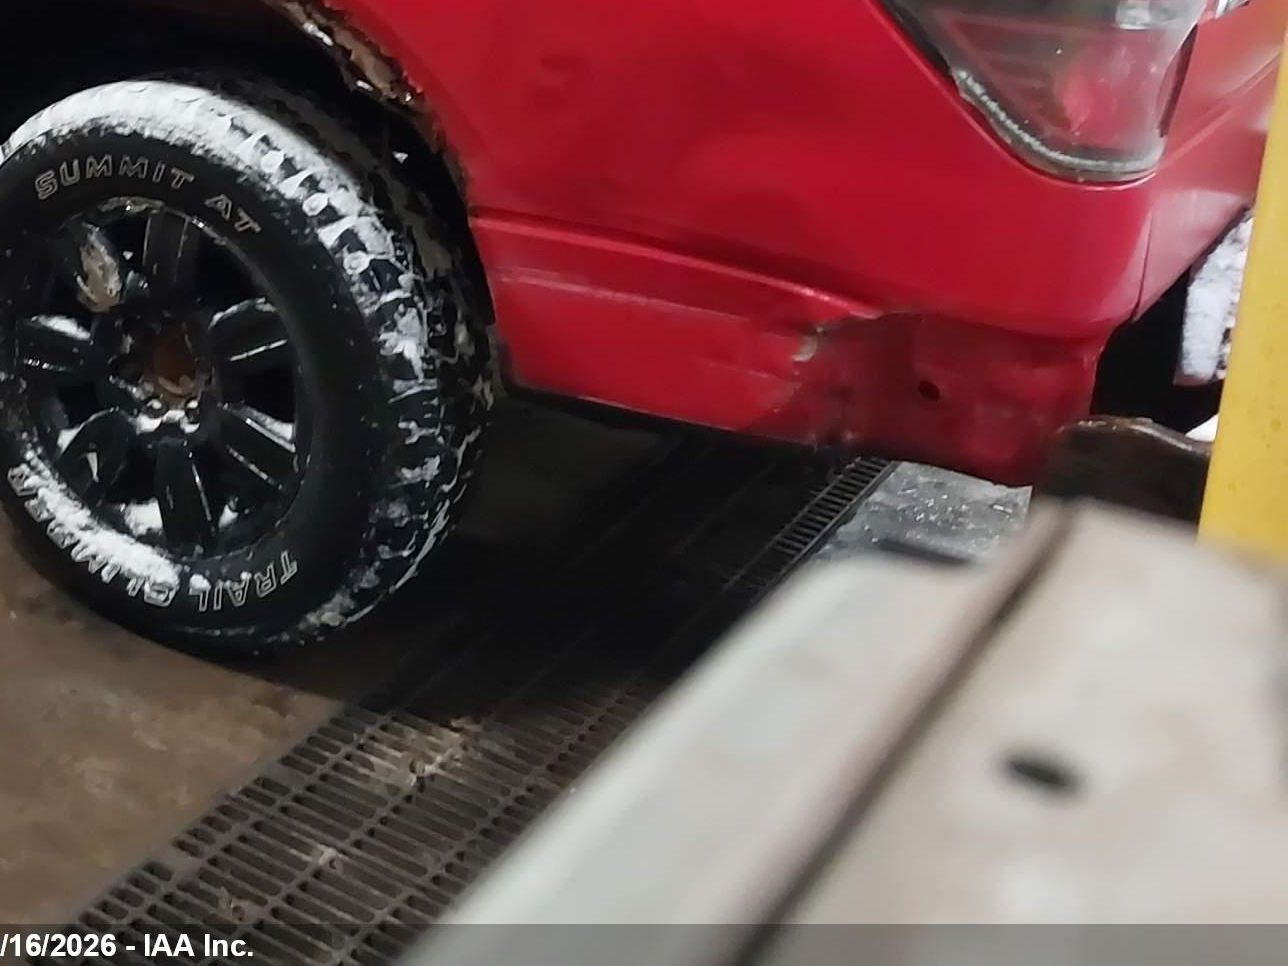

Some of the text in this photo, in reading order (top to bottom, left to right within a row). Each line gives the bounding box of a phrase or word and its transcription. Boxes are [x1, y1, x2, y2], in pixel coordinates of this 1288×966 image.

[33, 153, 262, 234] SUMMIT AT
[187, 549, 299, 613] TRAIL
